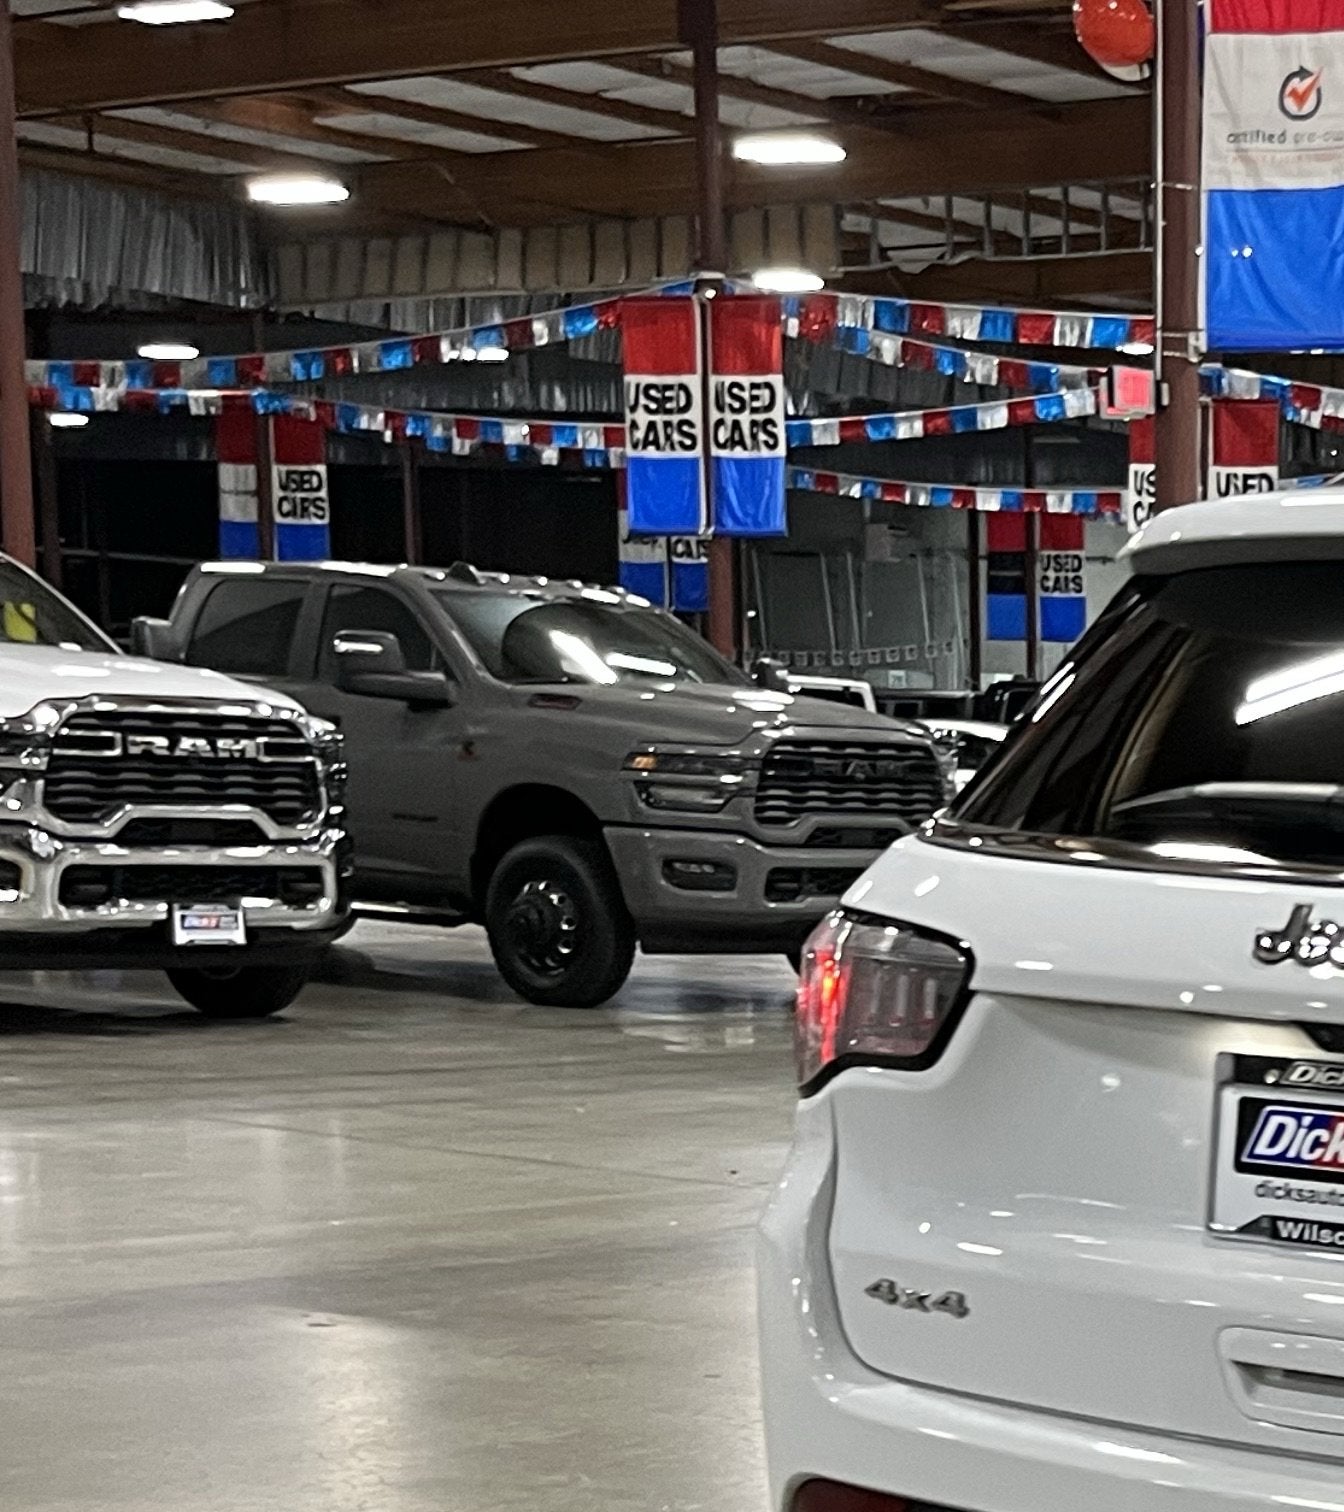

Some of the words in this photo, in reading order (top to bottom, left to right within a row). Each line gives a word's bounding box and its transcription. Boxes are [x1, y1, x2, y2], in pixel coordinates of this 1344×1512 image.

[625, 382, 693, 415] USED
[714, 381, 777, 415] USED
[628, 418, 698, 451] CARS
[713, 418, 779, 452] CARS
[278, 470, 323, 493] USED
[126, 735, 258, 758] RAM
